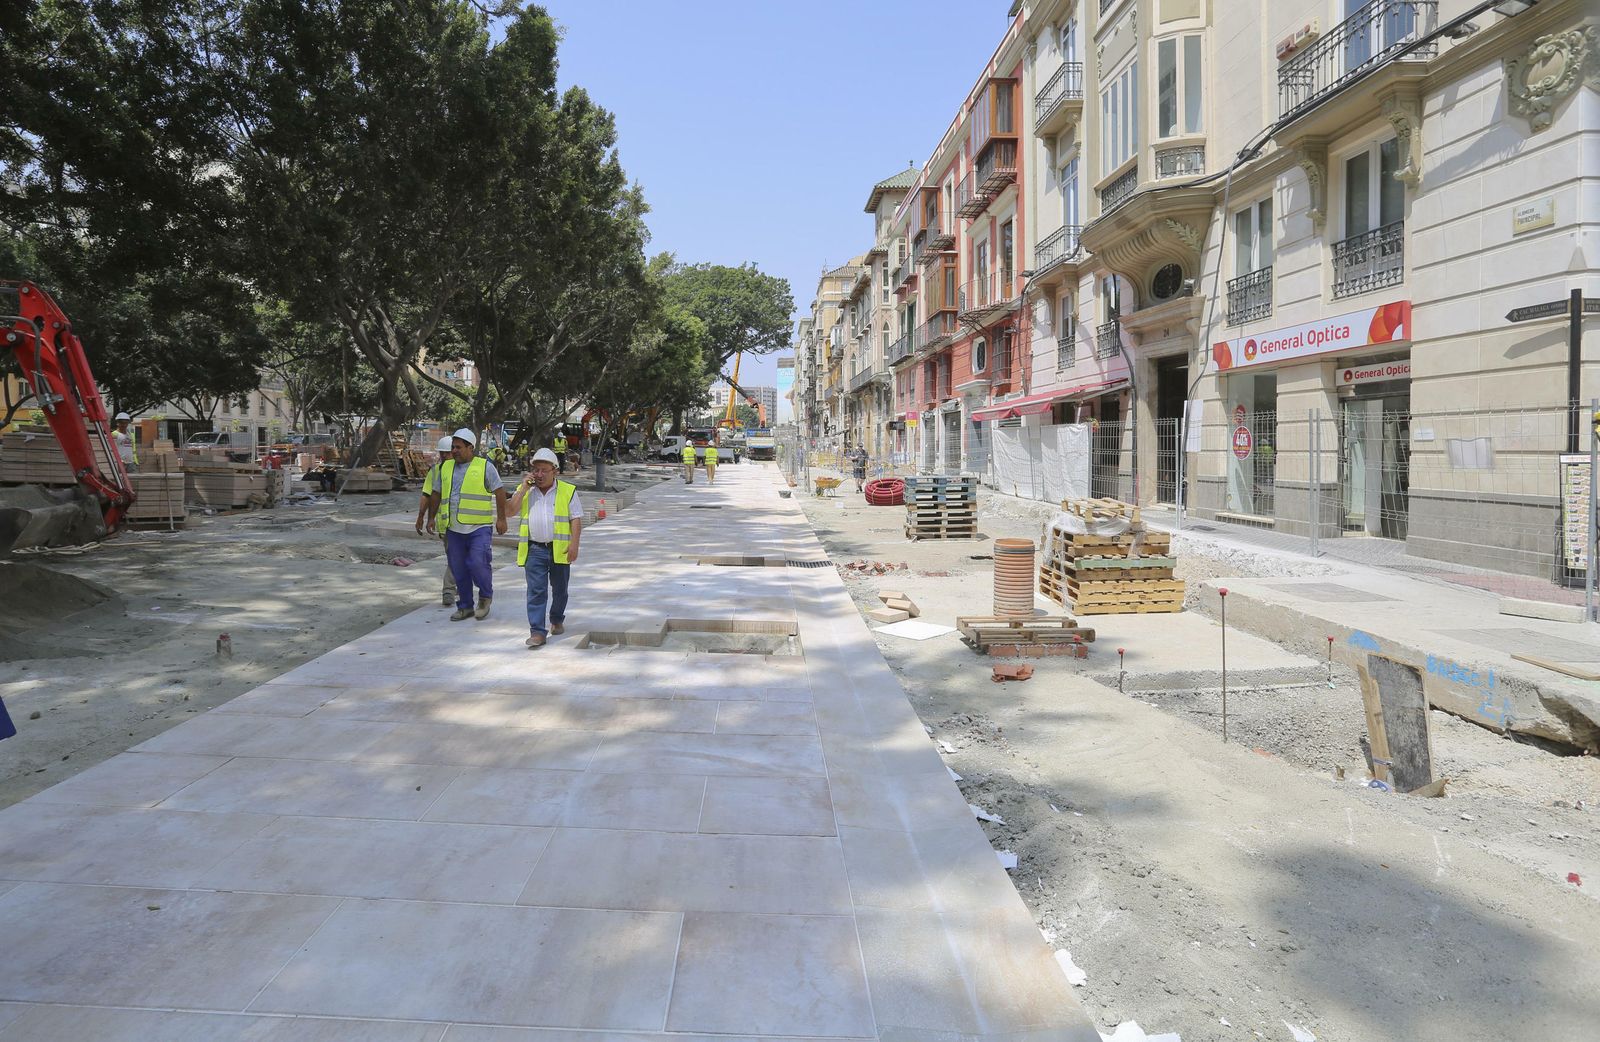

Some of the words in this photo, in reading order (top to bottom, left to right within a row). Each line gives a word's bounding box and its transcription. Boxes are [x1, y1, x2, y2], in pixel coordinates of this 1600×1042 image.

[1260, 332, 1304, 354] General
[1307, 325, 1350, 347] Optica
[1354, 367, 1384, 379] General
